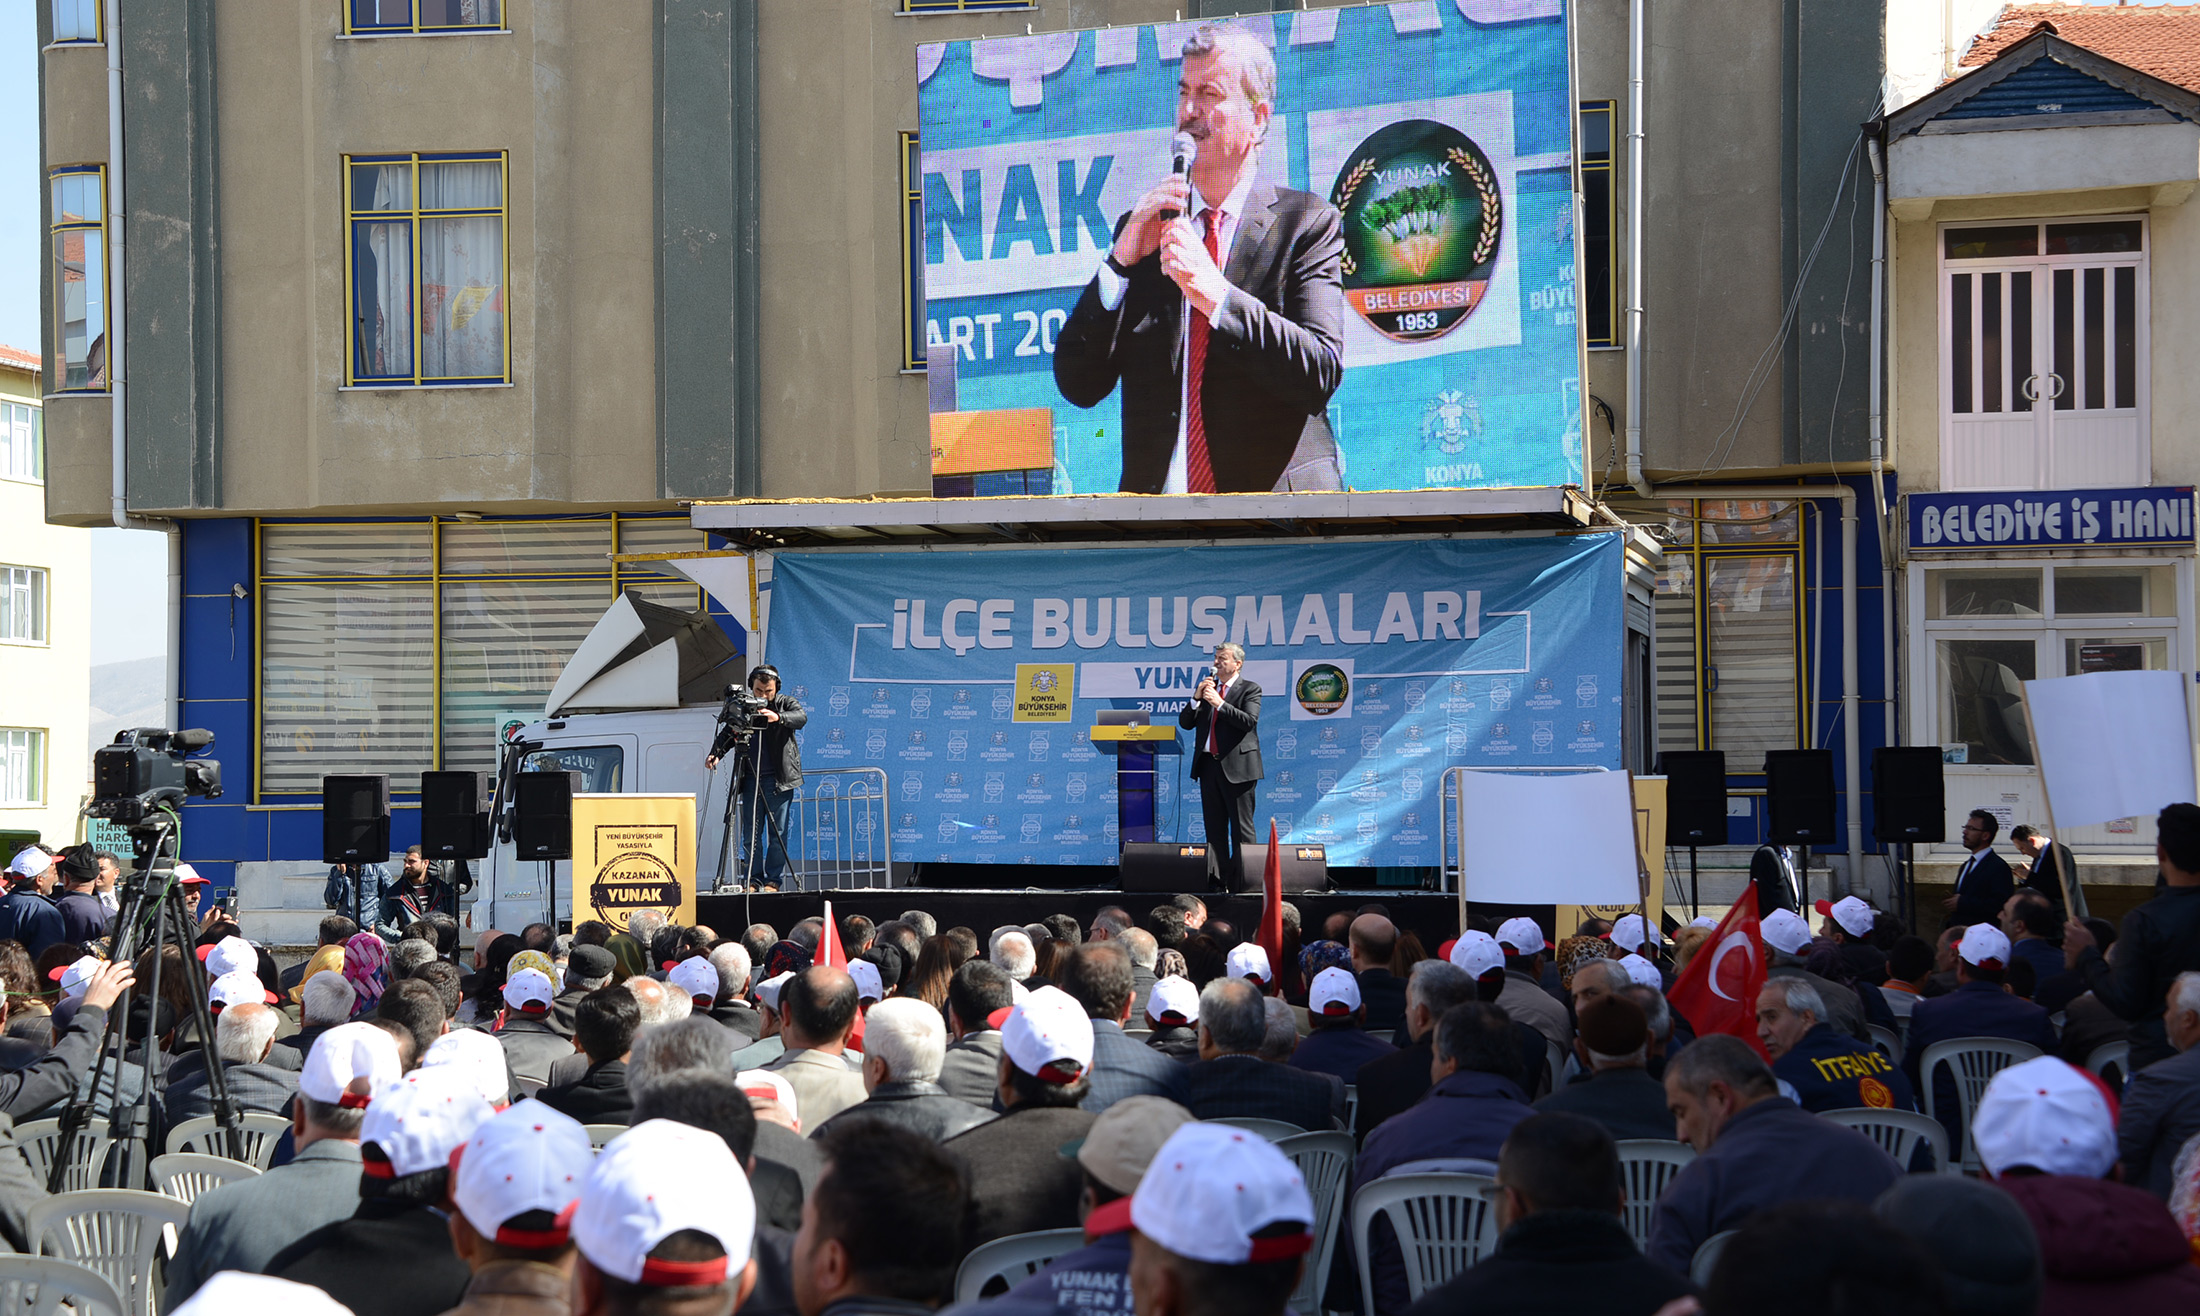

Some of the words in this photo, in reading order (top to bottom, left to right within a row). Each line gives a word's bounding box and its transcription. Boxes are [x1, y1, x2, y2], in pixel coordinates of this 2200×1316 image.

[1372, 160, 1452, 185] YUNAK
[923, 155, 1114, 264] NAK
[1396, 311, 1438, 331] 1953
[1425, 463, 1484, 484] KONYA
[1922, 499, 2061, 544] BELEDİYE
[2111, 498, 2191, 538] HANI
[892, 599, 1014, 656] İLÇE
[1032, 590, 1481, 654] BULUŞMALARI
[1134, 667, 1213, 690] YUNA
[1018, 701, 1067, 711] BÜYÜKŞEHİR
[1137, 702, 1154, 713] 28
[606, 832, 621, 840] YENİ
[622, 832, 663, 840] BÜYÜKŞEHİR
[96, 843, 133, 852] BİTME
[612, 871, 660, 880] KAZANAN
[607, 888, 662, 902] YUNAK
[1051, 1270, 1119, 1291] YUNAK
[1058, 1289, 1116, 1307] FEN
